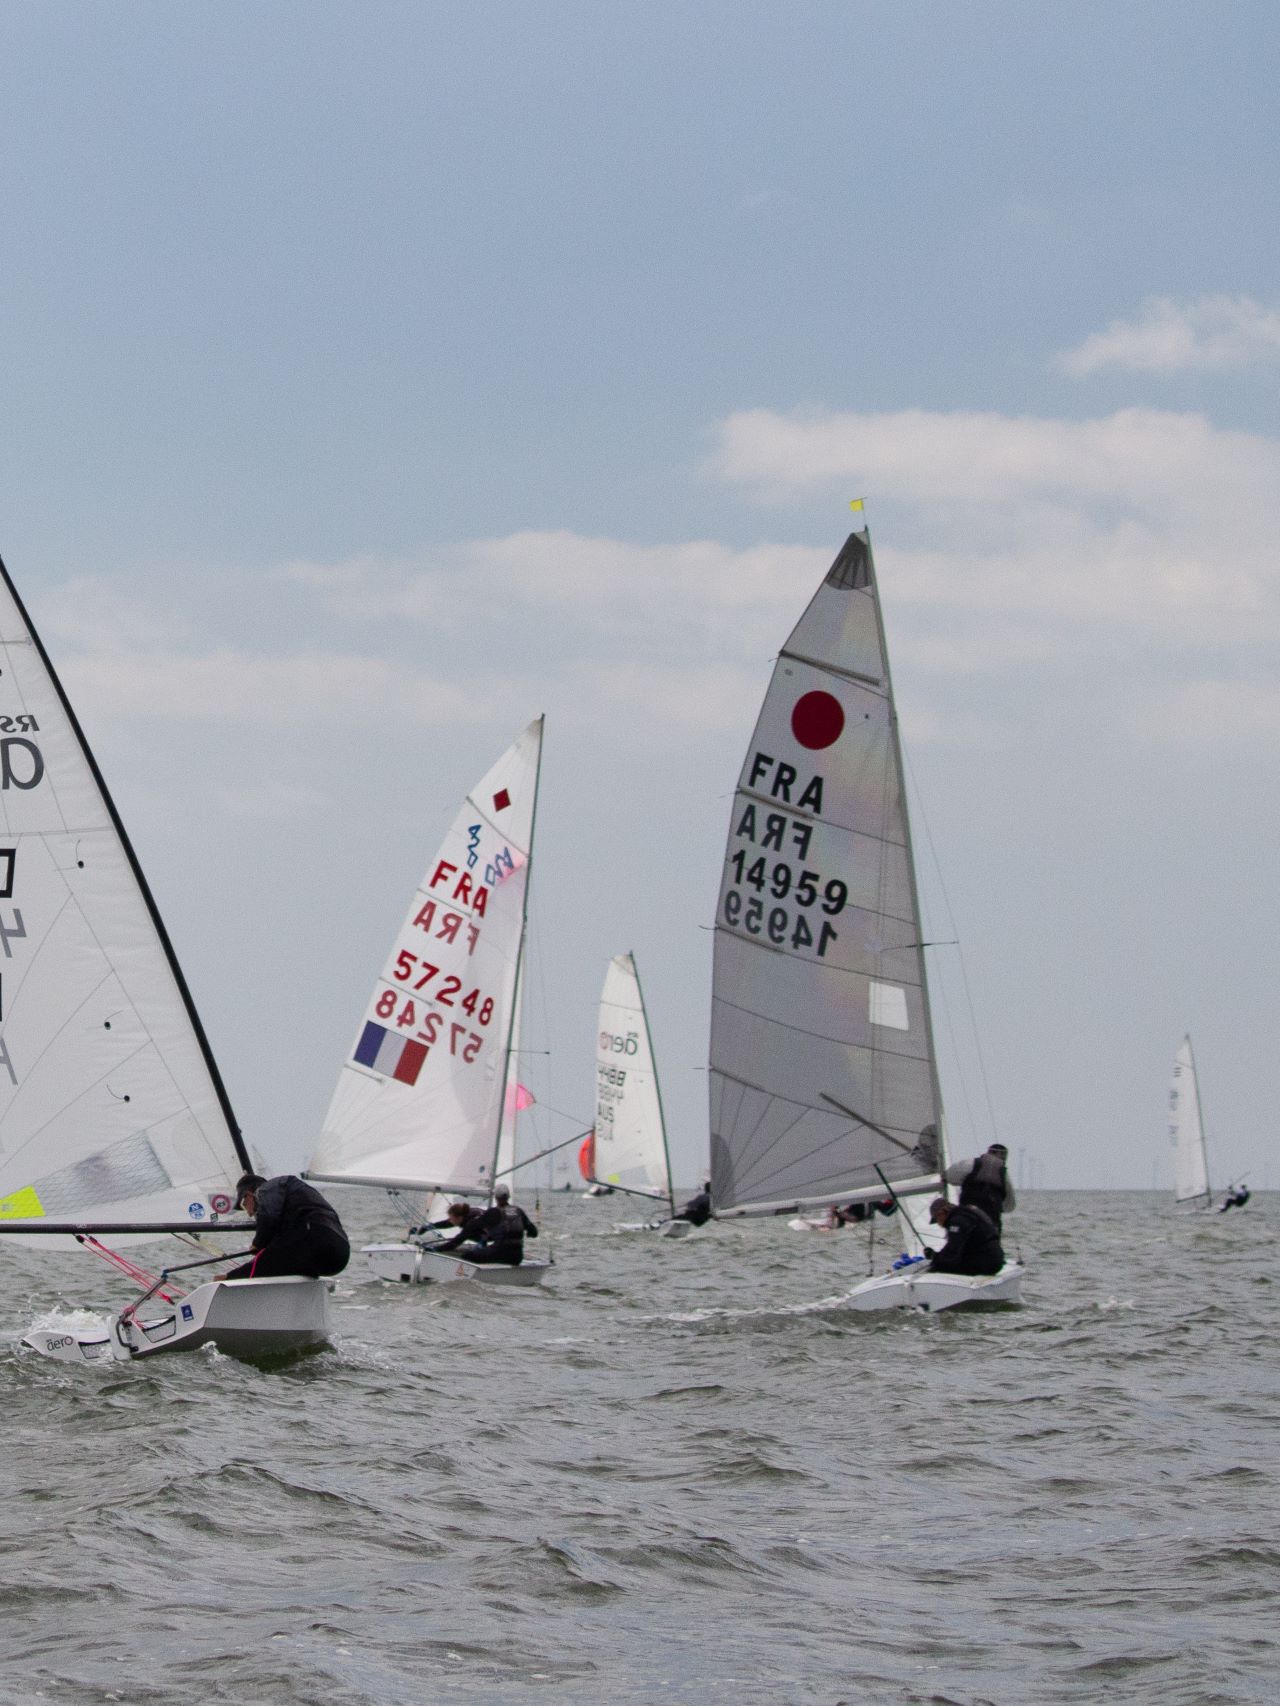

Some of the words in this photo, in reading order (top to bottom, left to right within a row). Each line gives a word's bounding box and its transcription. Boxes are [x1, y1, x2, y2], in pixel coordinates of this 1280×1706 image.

[748, 752, 824, 814] FRA
[429, 860, 489, 919] FRA
[731, 849, 849, 916] 14959
[393, 949, 494, 1026] 57248
